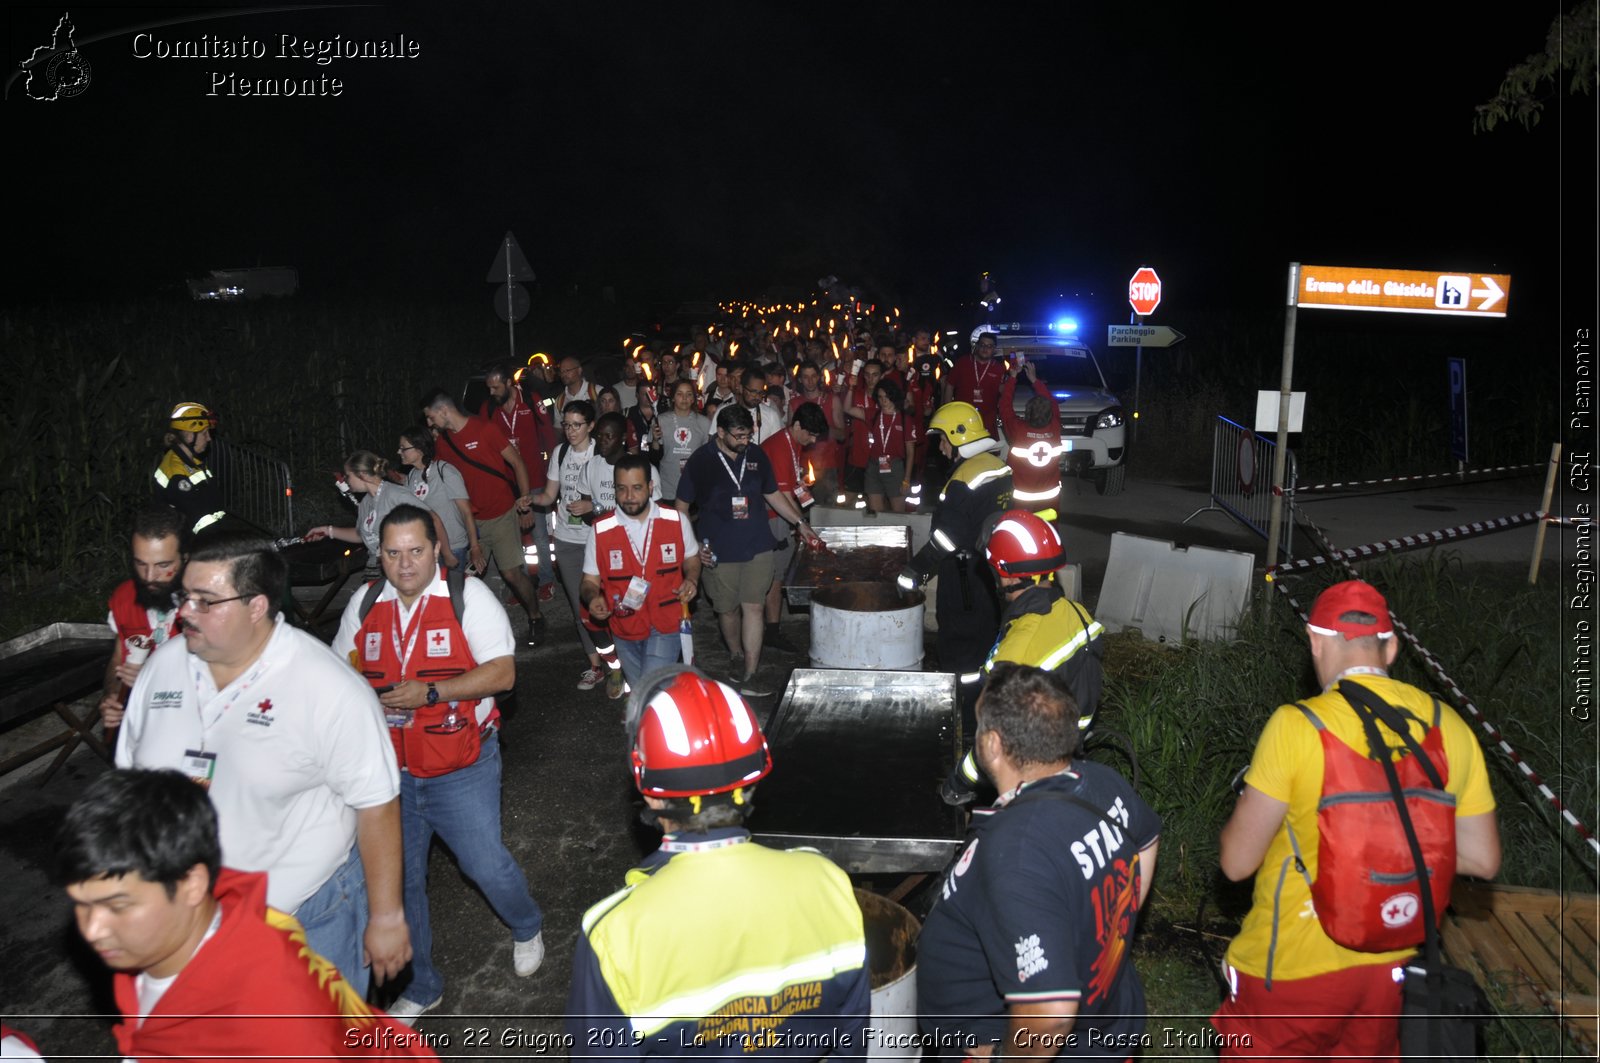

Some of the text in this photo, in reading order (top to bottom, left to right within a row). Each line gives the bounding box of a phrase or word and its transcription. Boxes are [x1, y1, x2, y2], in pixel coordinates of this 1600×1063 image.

[1131, 282, 1158, 301] STOP
[1347, 280, 1380, 296] della
[1384, 280, 1435, 298] Ghisiola
[1111, 327, 1155, 336] Parcheggio
[1111, 336, 1141, 344] Parking
[783, 981, 822, 1002] PAVIA
